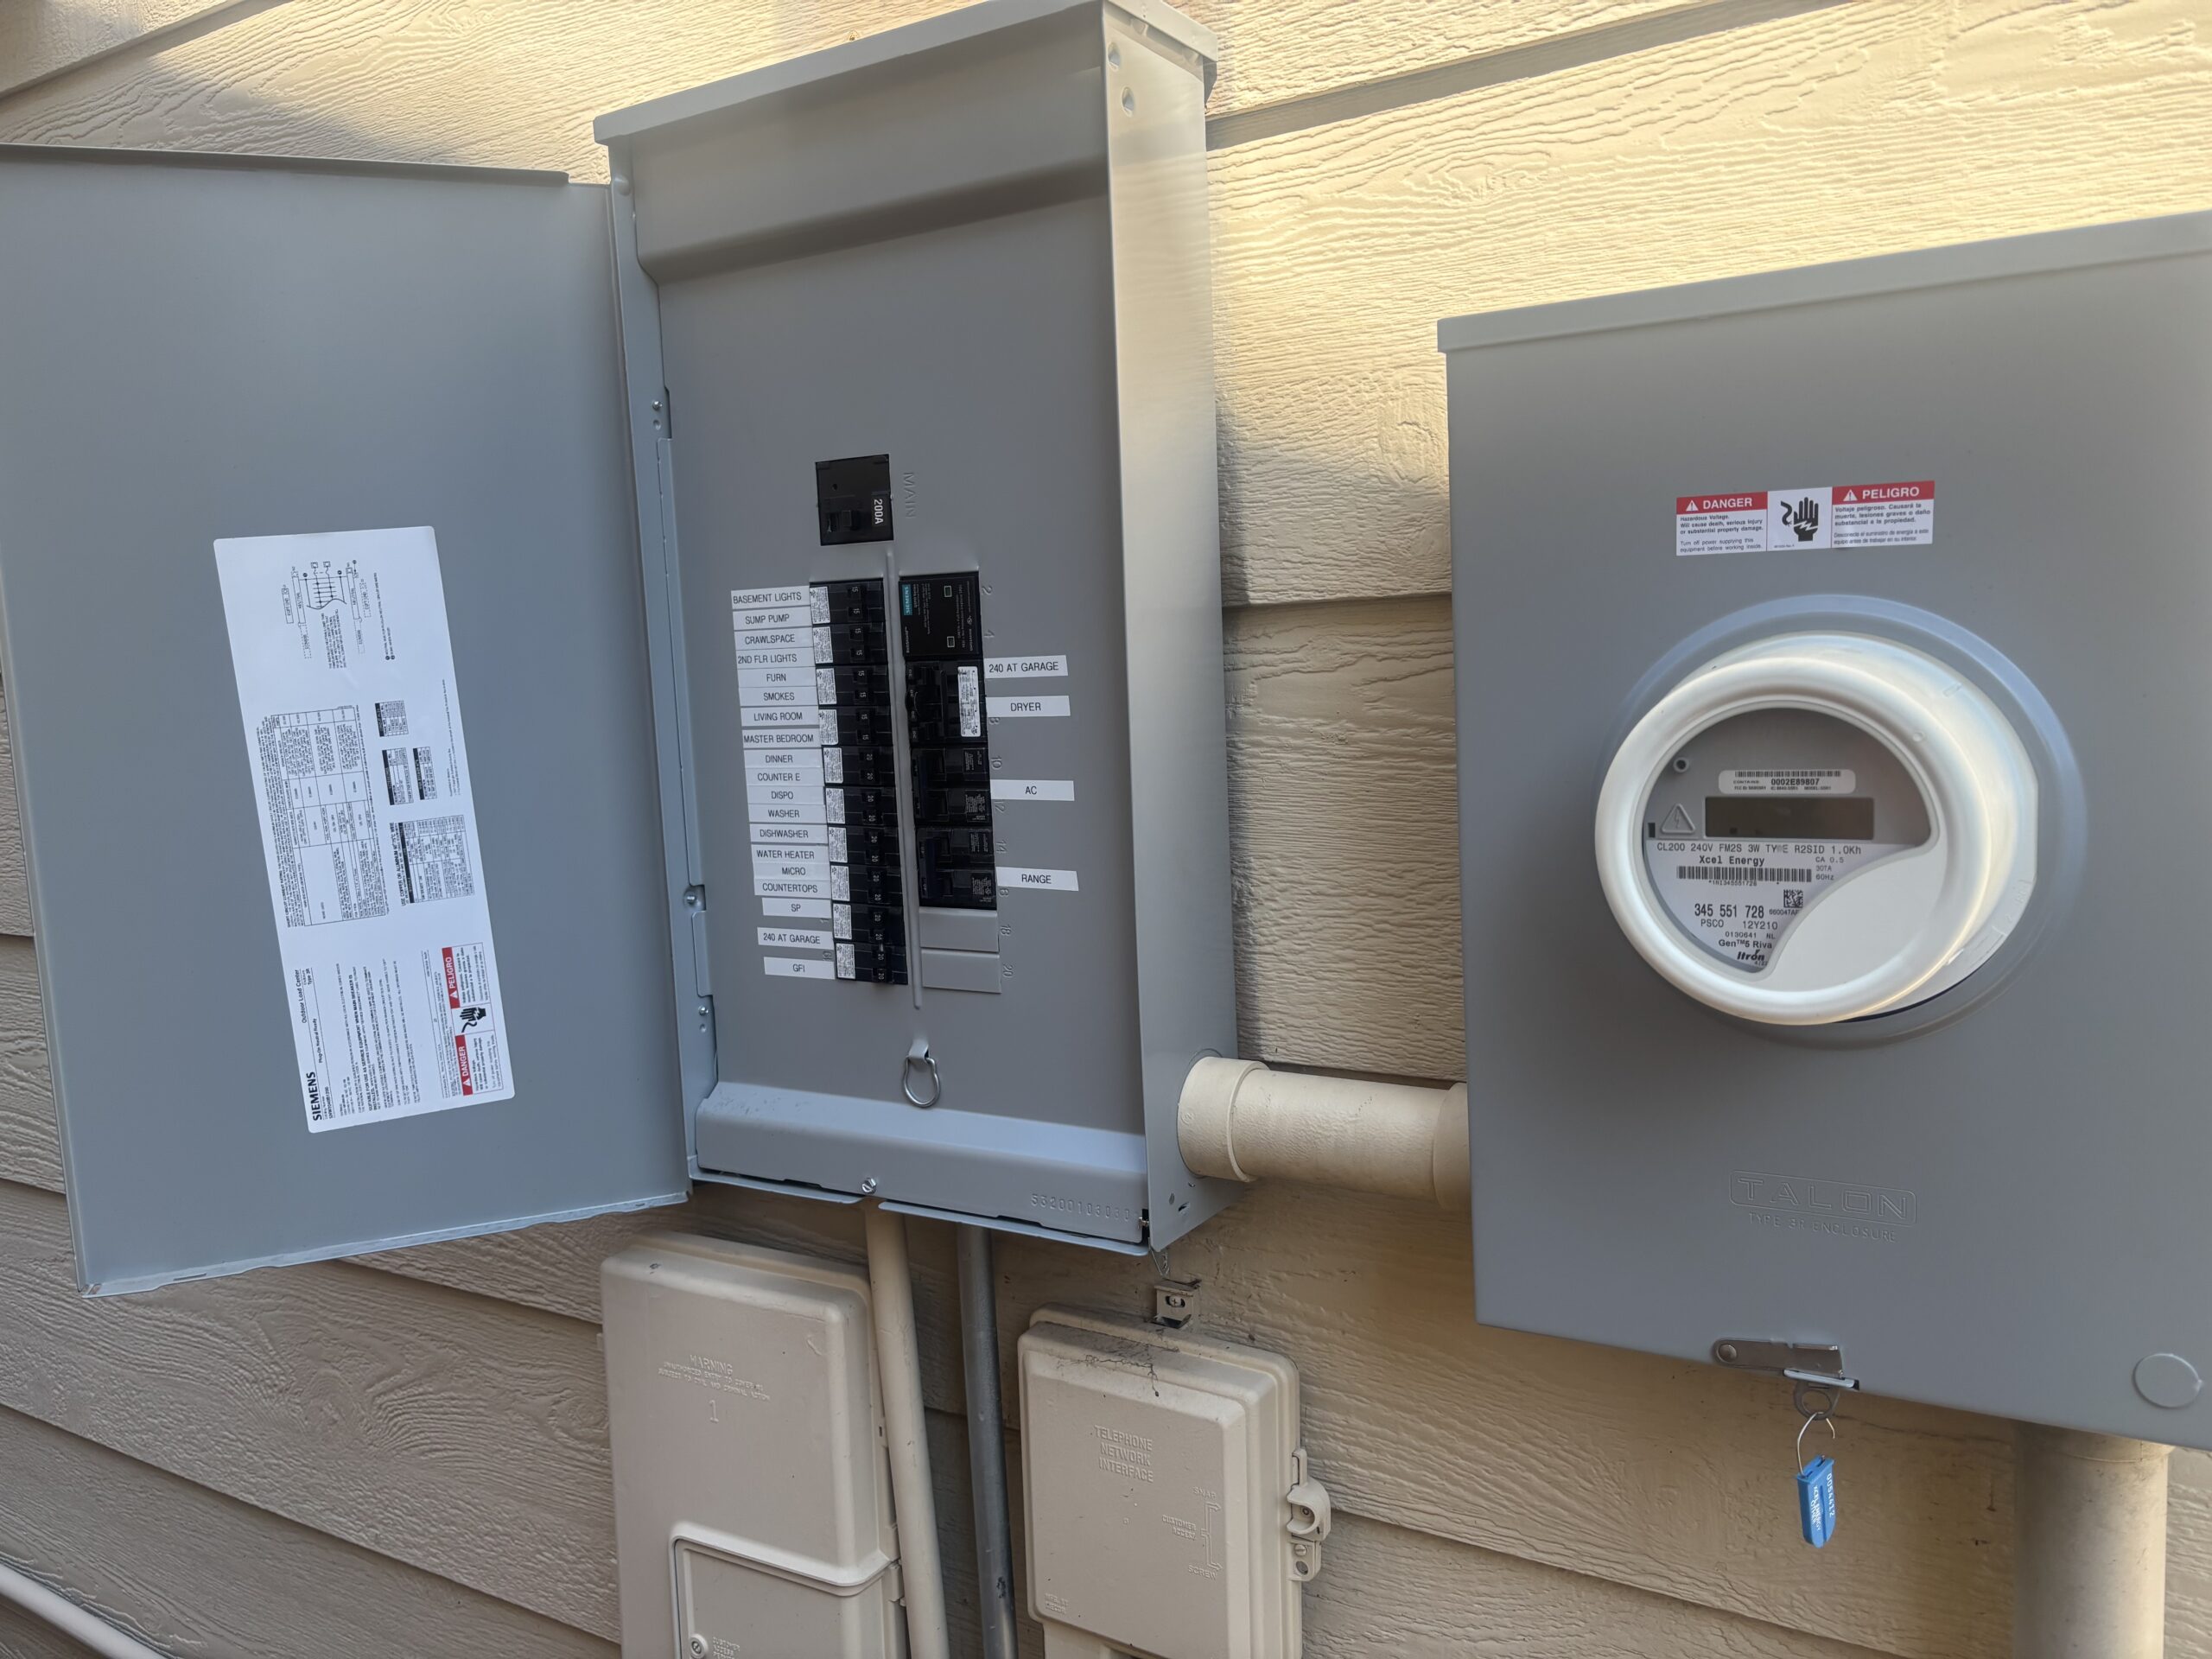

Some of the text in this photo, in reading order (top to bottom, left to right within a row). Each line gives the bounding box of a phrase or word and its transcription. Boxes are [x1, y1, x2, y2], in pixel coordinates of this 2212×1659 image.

[903, 472, 918, 518] MAIN
[1862, 486, 1920, 499] PELIGRO
[1703, 497, 1752, 510] DANGER
[874, 499, 884, 524] 200A
[733, 591, 802, 605] BASEMENT LIGHTS
[745, 613, 790, 625] SUMP PUMP
[745, 634, 796, 645] CRAWLSPACE
[737, 653, 798, 664] 2ND FLR LIGHTS
[988, 661, 1059, 673] 240 AT GARAGE
[766, 673, 786, 682] FURN
[763, 692, 795, 701] SMOKES
[1010, 702, 1041, 712] DRYER
[753, 712, 803, 721] LIVING ROOM
[744, 734, 814, 743] MASTER BEDROOM
[766, 754, 793, 763] DINNER
[757, 772, 801, 781] COUNTER E
[1770, 778, 1820, 786] 0002E89807
[1025, 785, 1037, 795] AC
[768, 810, 800, 818] WASHER
[760, 829, 809, 838] DISHWASHER
[757, 849, 815, 860] WATER HEATER
[1656, 842, 1685, 851] CL200
[1690, 842, 1713, 852] 240V
[1719, 843, 1742, 853] FM2S
[1748, 843, 1760, 853] 3W
[1795, 844, 1825, 854] R2SID
[1831, 845, 1861, 855] 1.0Kh
[1699, 855, 1765, 868] Xcel Energy
[781, 867, 806, 876] MICRO
[1021, 874, 1052, 885] RANGE
[762, 883, 818, 893] COUNTERTOPS
[791, 904, 801, 912] SP
[1694, 903, 1764, 918] 345 551 728
[1700, 918, 1778, 931] PSCO 12Y210
[763, 932, 821, 944] 240 AT GARAGE
[1752, 940, 1772, 949] Riva
[1737, 950, 1765, 961] Itron
[444, 956, 455, 988] PELIGRO
[792, 963, 805, 972] GFI
[457, 1046, 468, 1076] DANGER
[305, 1071, 322, 1121] SIEMENS
[1737, 1177, 1907, 1220] TALON
[1813, 1222, 1897, 1243] ENCLOSURE
[1094, 1425, 1153, 1452] TELEPHONE
[1100, 1441, 1151, 1466] NETWORK
[1098, 1457, 1154, 1483] INTERFACE
[1826, 1472, 1835, 1518] 0054412
[1187, 1564, 1218, 1580] SCREW
